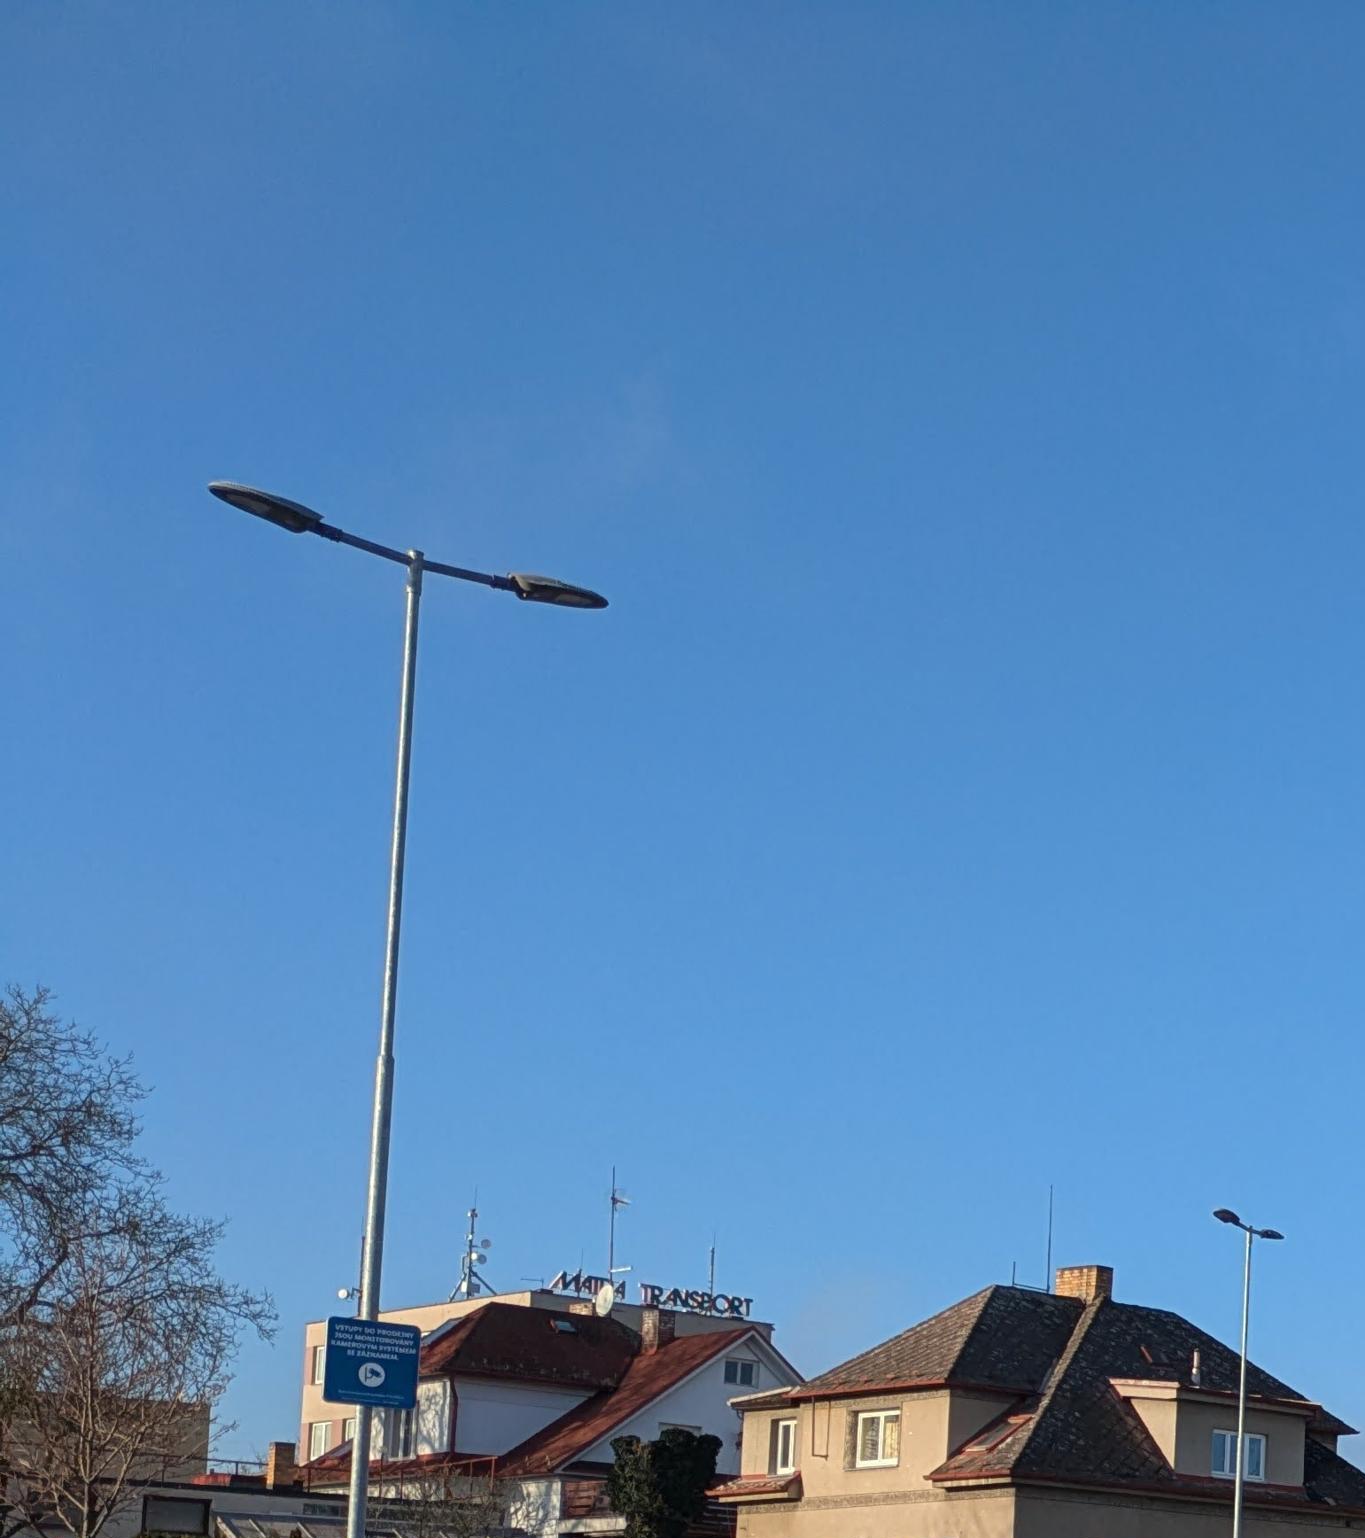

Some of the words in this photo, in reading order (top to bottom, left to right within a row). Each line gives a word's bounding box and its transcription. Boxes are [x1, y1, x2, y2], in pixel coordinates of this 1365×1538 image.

[638, 1282, 753, 1317] TRANSPORT
[335, 1324, 362, 1333] VSTUPY
[377, 1329, 415, 1339] PRODEJNY
[335, 1332, 353, 1340] JSOU
